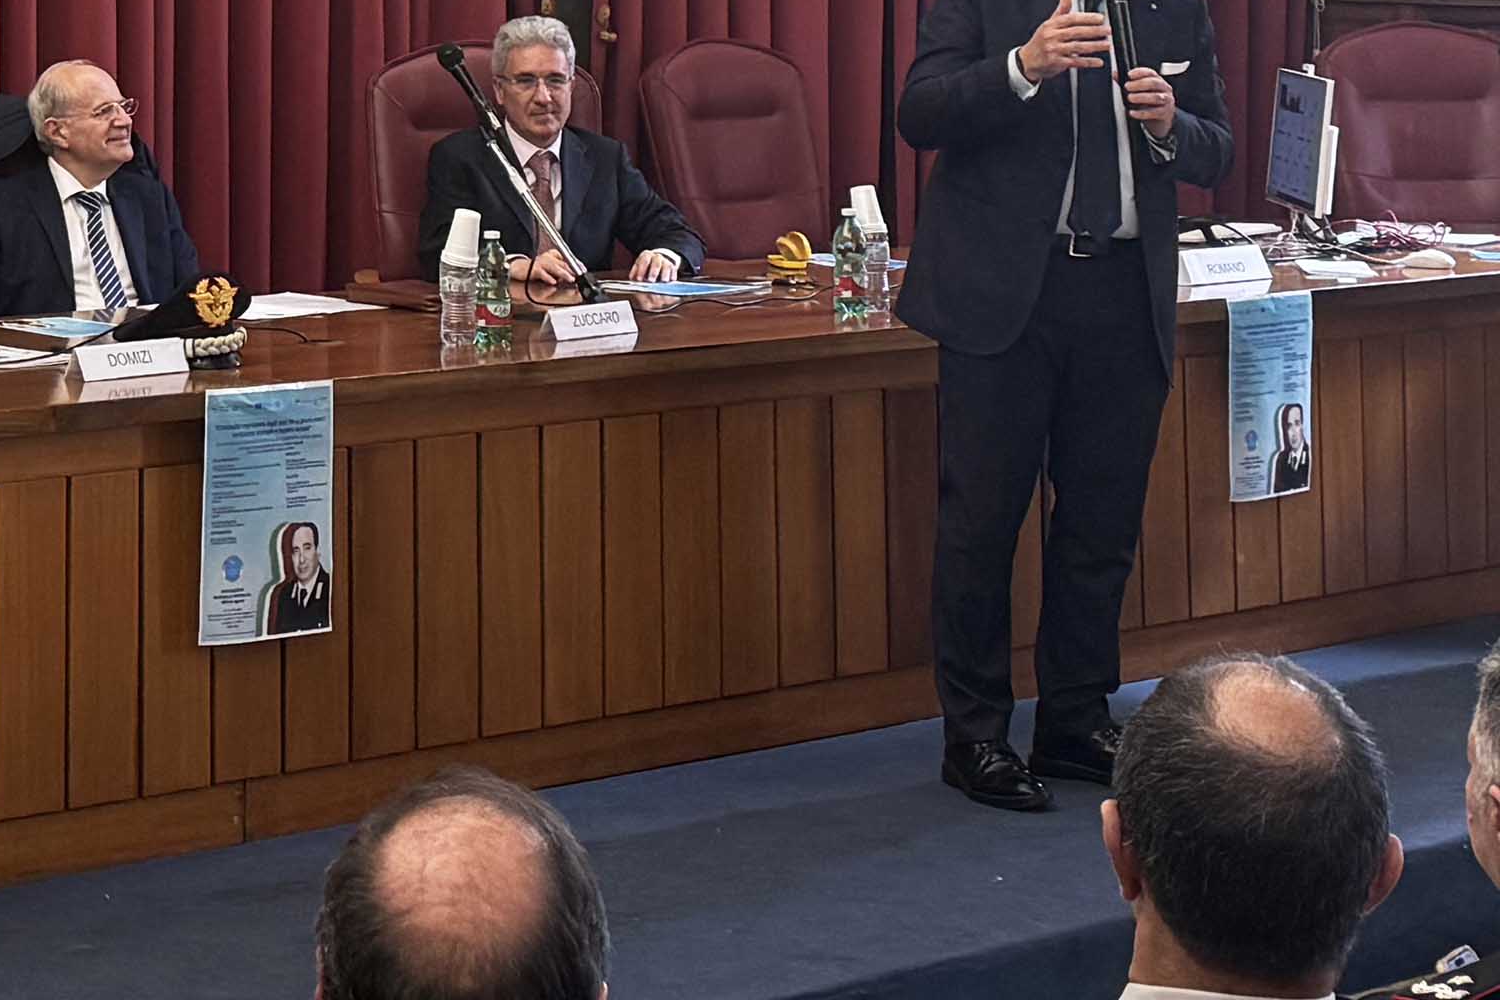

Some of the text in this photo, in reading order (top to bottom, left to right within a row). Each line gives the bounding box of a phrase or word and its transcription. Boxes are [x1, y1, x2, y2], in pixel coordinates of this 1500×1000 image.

[1206, 261, 1246, 275] ROMANO
[571, 310, 620, 328] ZUCCARO
[107, 349, 153, 368] DOMIZI
